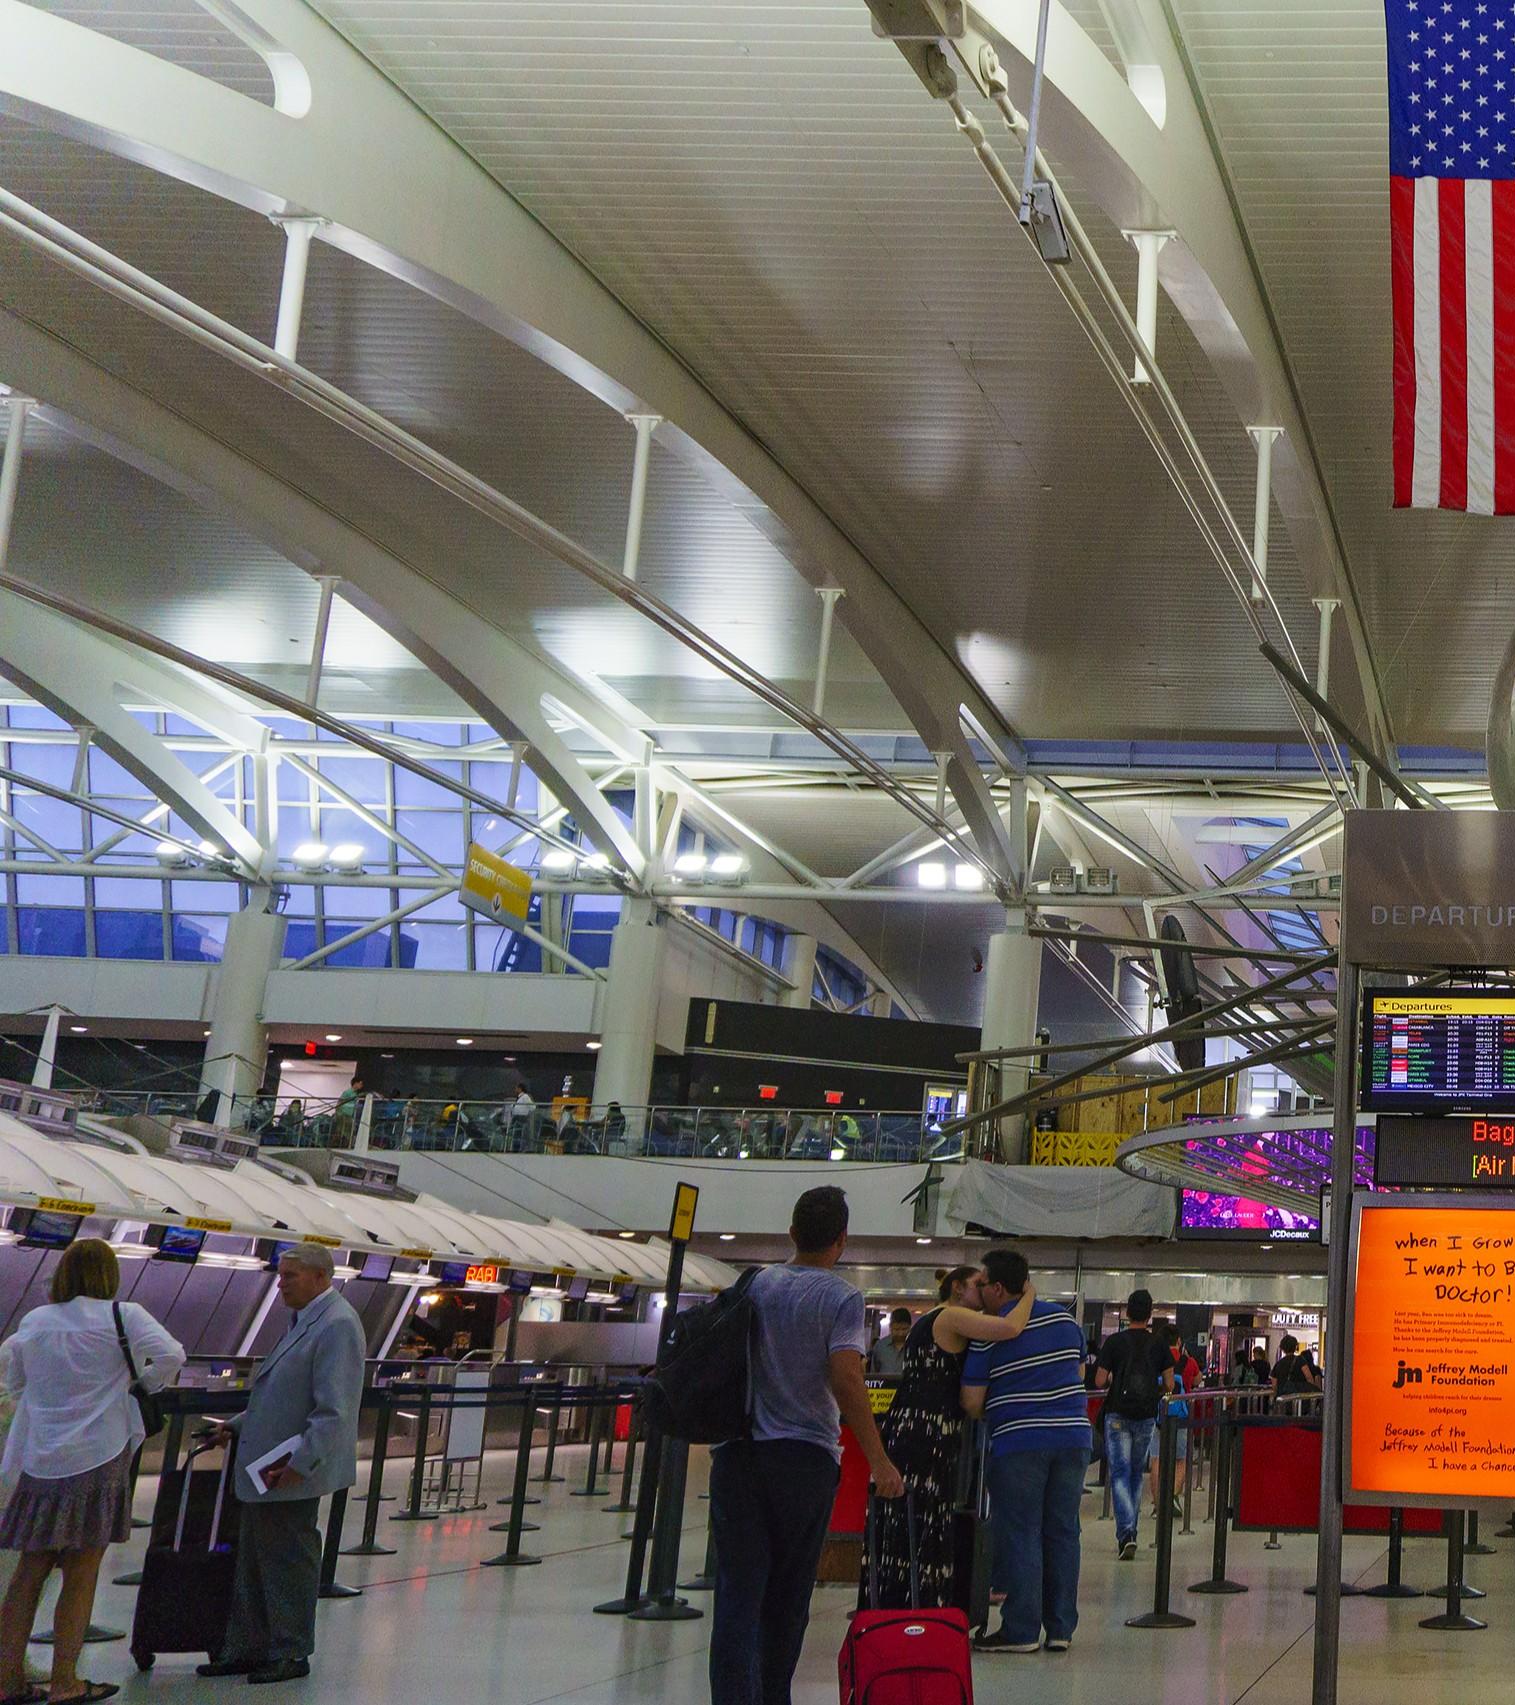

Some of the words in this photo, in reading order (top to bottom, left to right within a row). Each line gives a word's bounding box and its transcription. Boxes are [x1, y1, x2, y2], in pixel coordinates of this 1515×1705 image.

[1392, 1002, 1453, 1012] Departures
[1270, 1229, 1309, 1239] JCDecaux
[1447, 1236, 1462, 1250] I
[1404, 1257, 1418, 1276] I
[1423, 1258, 1467, 1277] want
[1272, 1313, 1297, 1324] DUTY
[1299, 1313, 1319, 1324] FREE
[1426, 1363, 1466, 1376] Jeffrey
[1469, 1364, 1508, 1375] Modell
[1431, 1375, 1495, 1386] Foundation
[1428, 1406, 1467, 1416] info4pi.org
[1384, 1422, 1425, 1437] Because
[1431, 1423, 1444, 1438] of
[1449, 1426, 1466, 1438] the
[1380, 1437, 1418, 1452] Jeffrey
[1428, 1457, 1437, 1469] I
[1443, 1458, 1467, 1471] have
[1470, 1463, 1477, 1471] a
